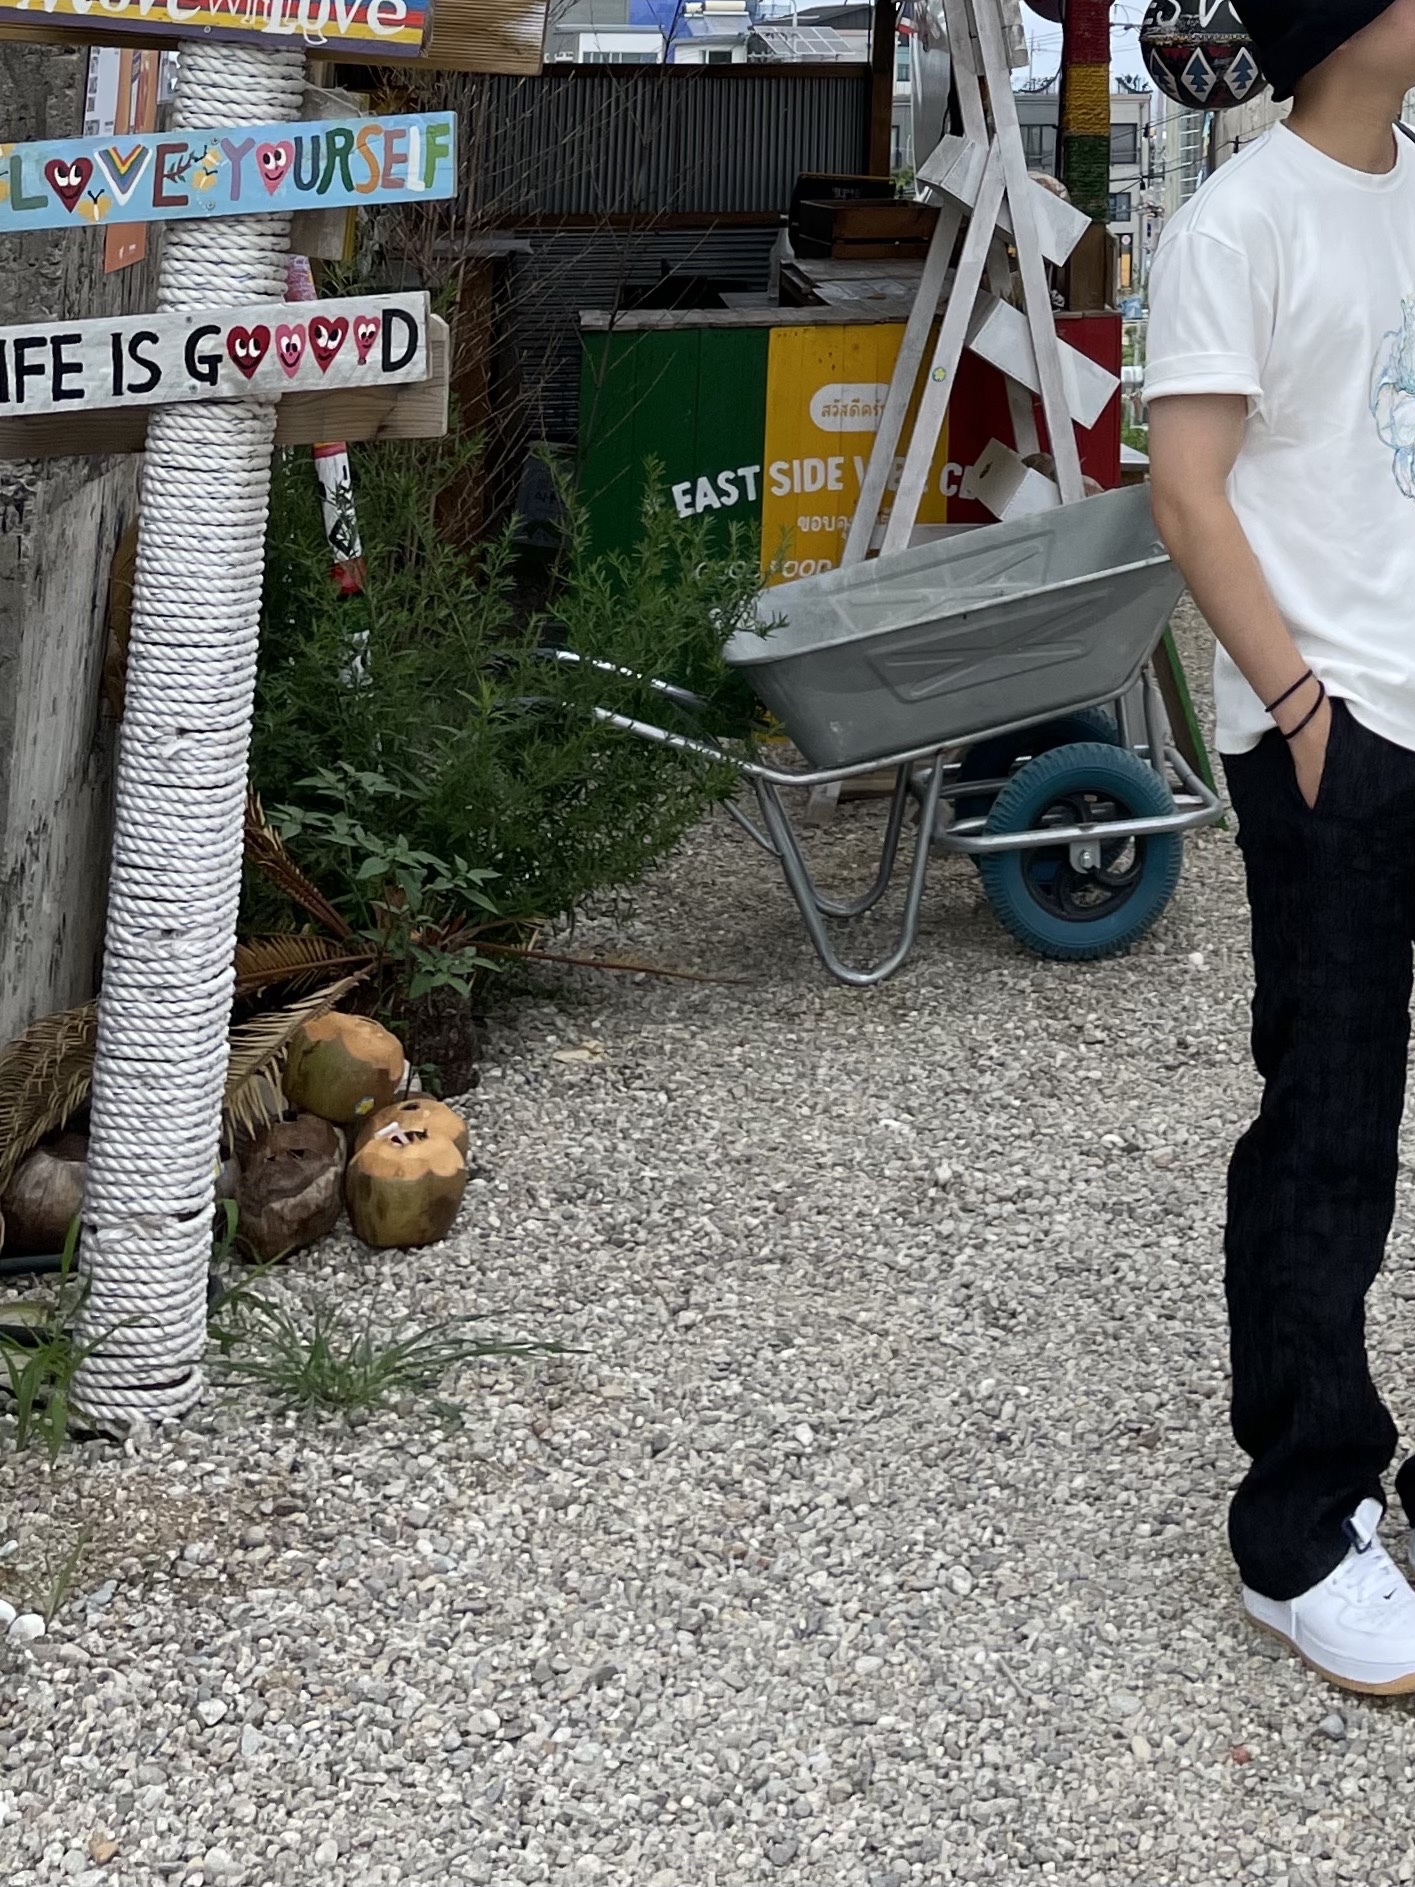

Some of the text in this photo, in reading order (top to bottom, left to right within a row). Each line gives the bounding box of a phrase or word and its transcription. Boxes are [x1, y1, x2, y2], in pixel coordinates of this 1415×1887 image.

[0, 332, 85, 404] IFE
[110, 330, 163, 397] IS
[671, 464, 761, 518] EAST
[769, 456, 845, 496] SIDE
[770, 559, 833, 579] OOD
